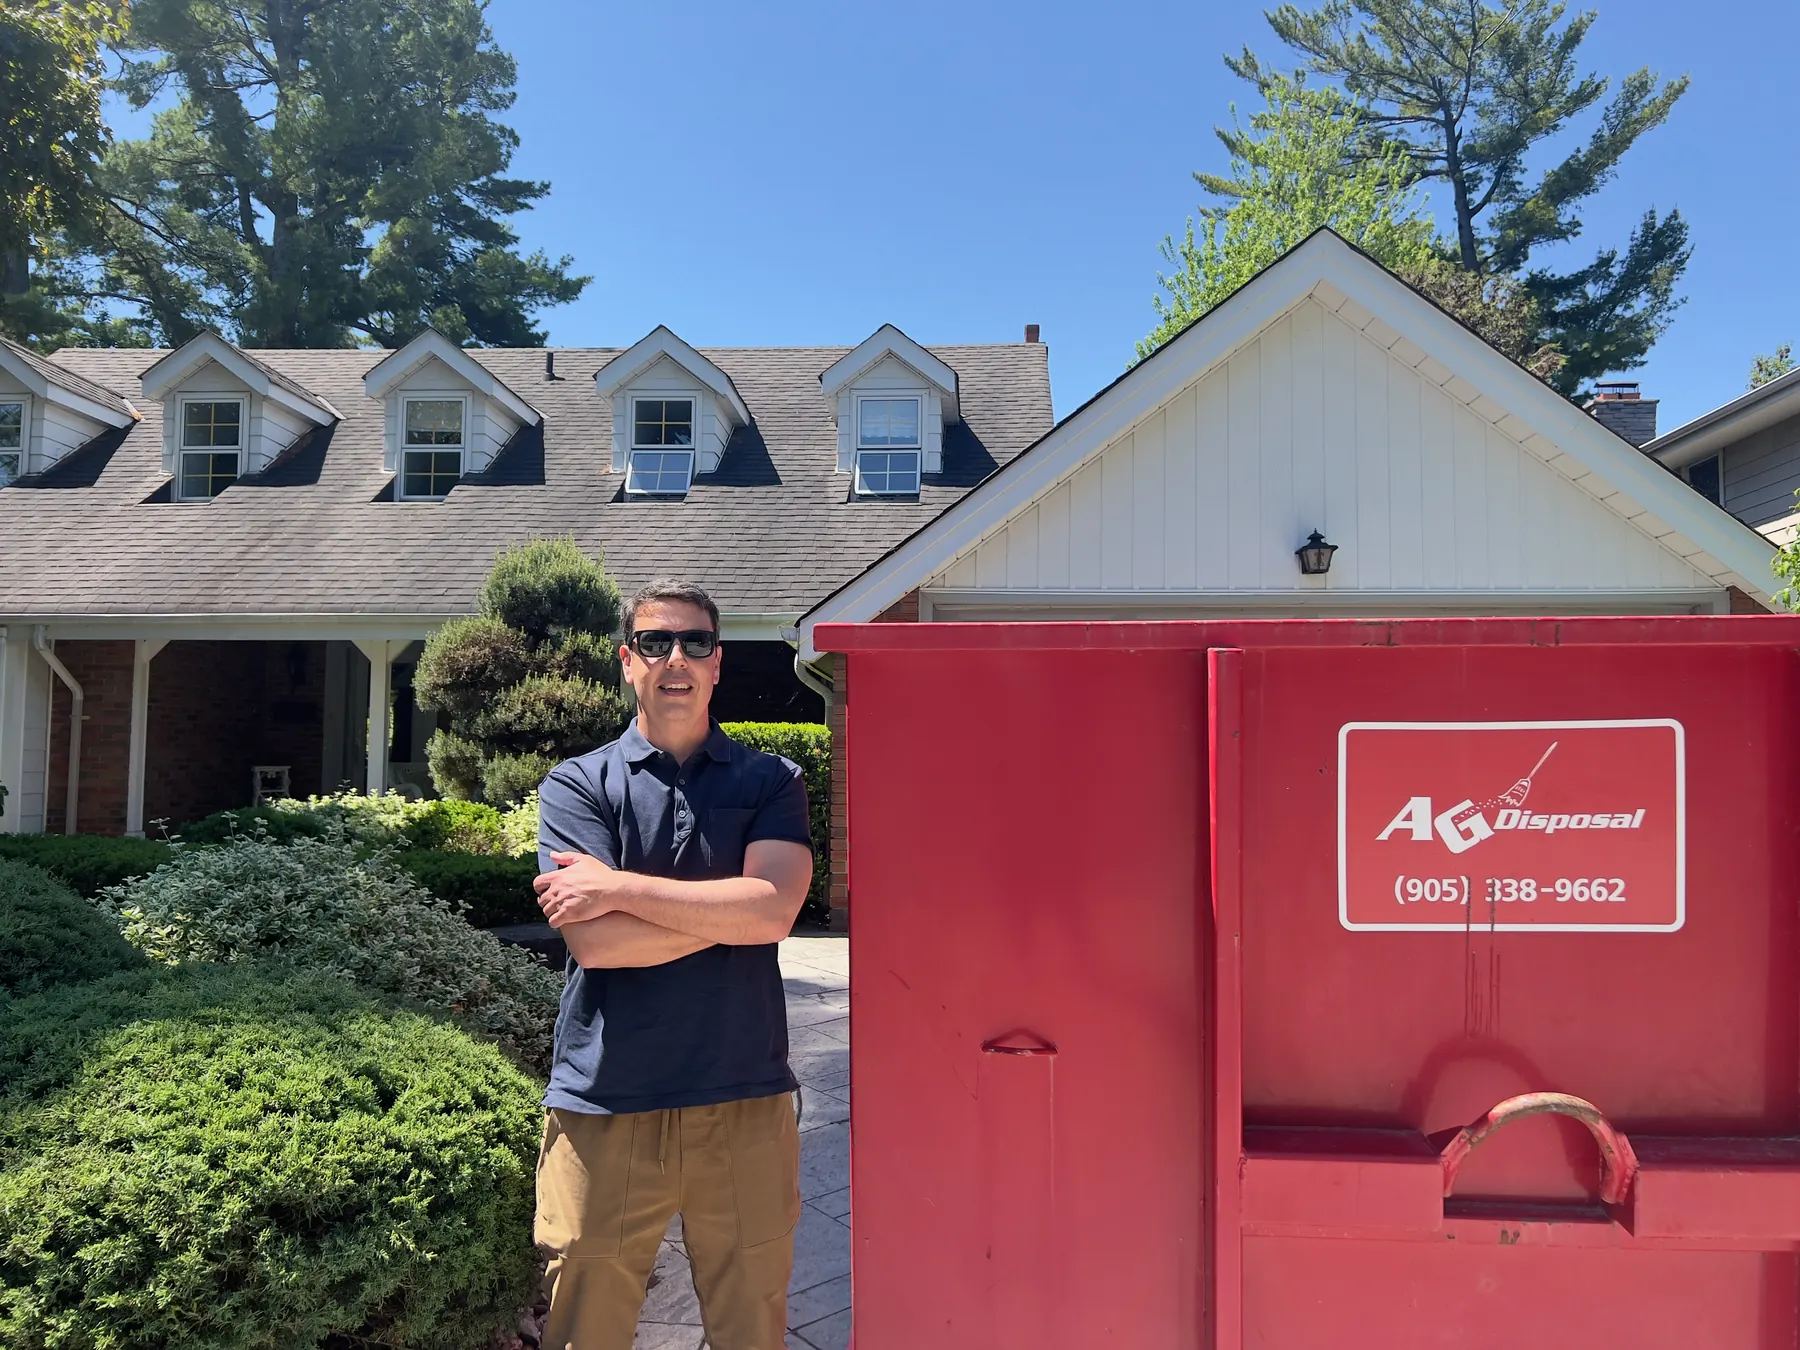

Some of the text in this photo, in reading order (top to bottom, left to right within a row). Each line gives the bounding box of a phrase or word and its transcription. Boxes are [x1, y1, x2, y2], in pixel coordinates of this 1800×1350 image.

[1375, 796, 1646, 854] AG Disposal
[1394, 875, 1626, 905] (905) 338-9662
